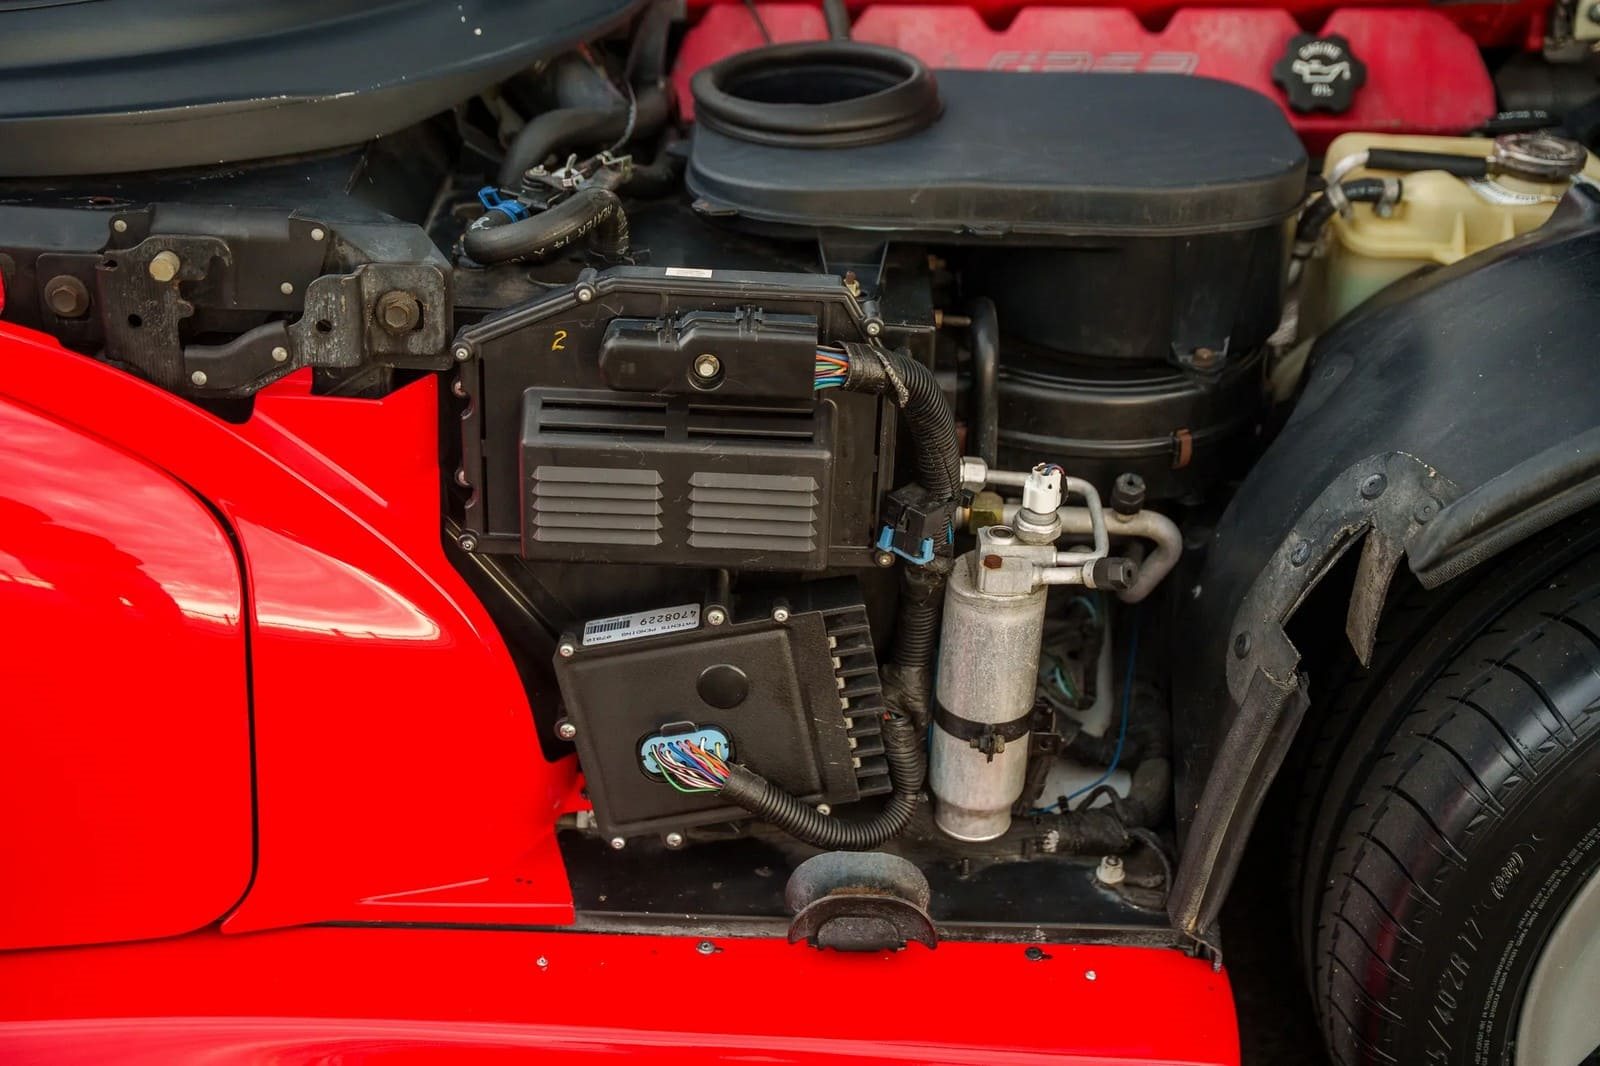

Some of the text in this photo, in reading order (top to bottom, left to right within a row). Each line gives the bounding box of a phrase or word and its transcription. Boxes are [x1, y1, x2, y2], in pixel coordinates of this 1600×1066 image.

[1298, 41, 1342, 60] ENGINE
[1311, 83, 1335, 97] OIL
[551, 329, 568, 352] 2
[640, 610, 697, 626] 4708229
[621, 627, 657, 637] PENDING
[661, 621, 697, 631] PATENTS
